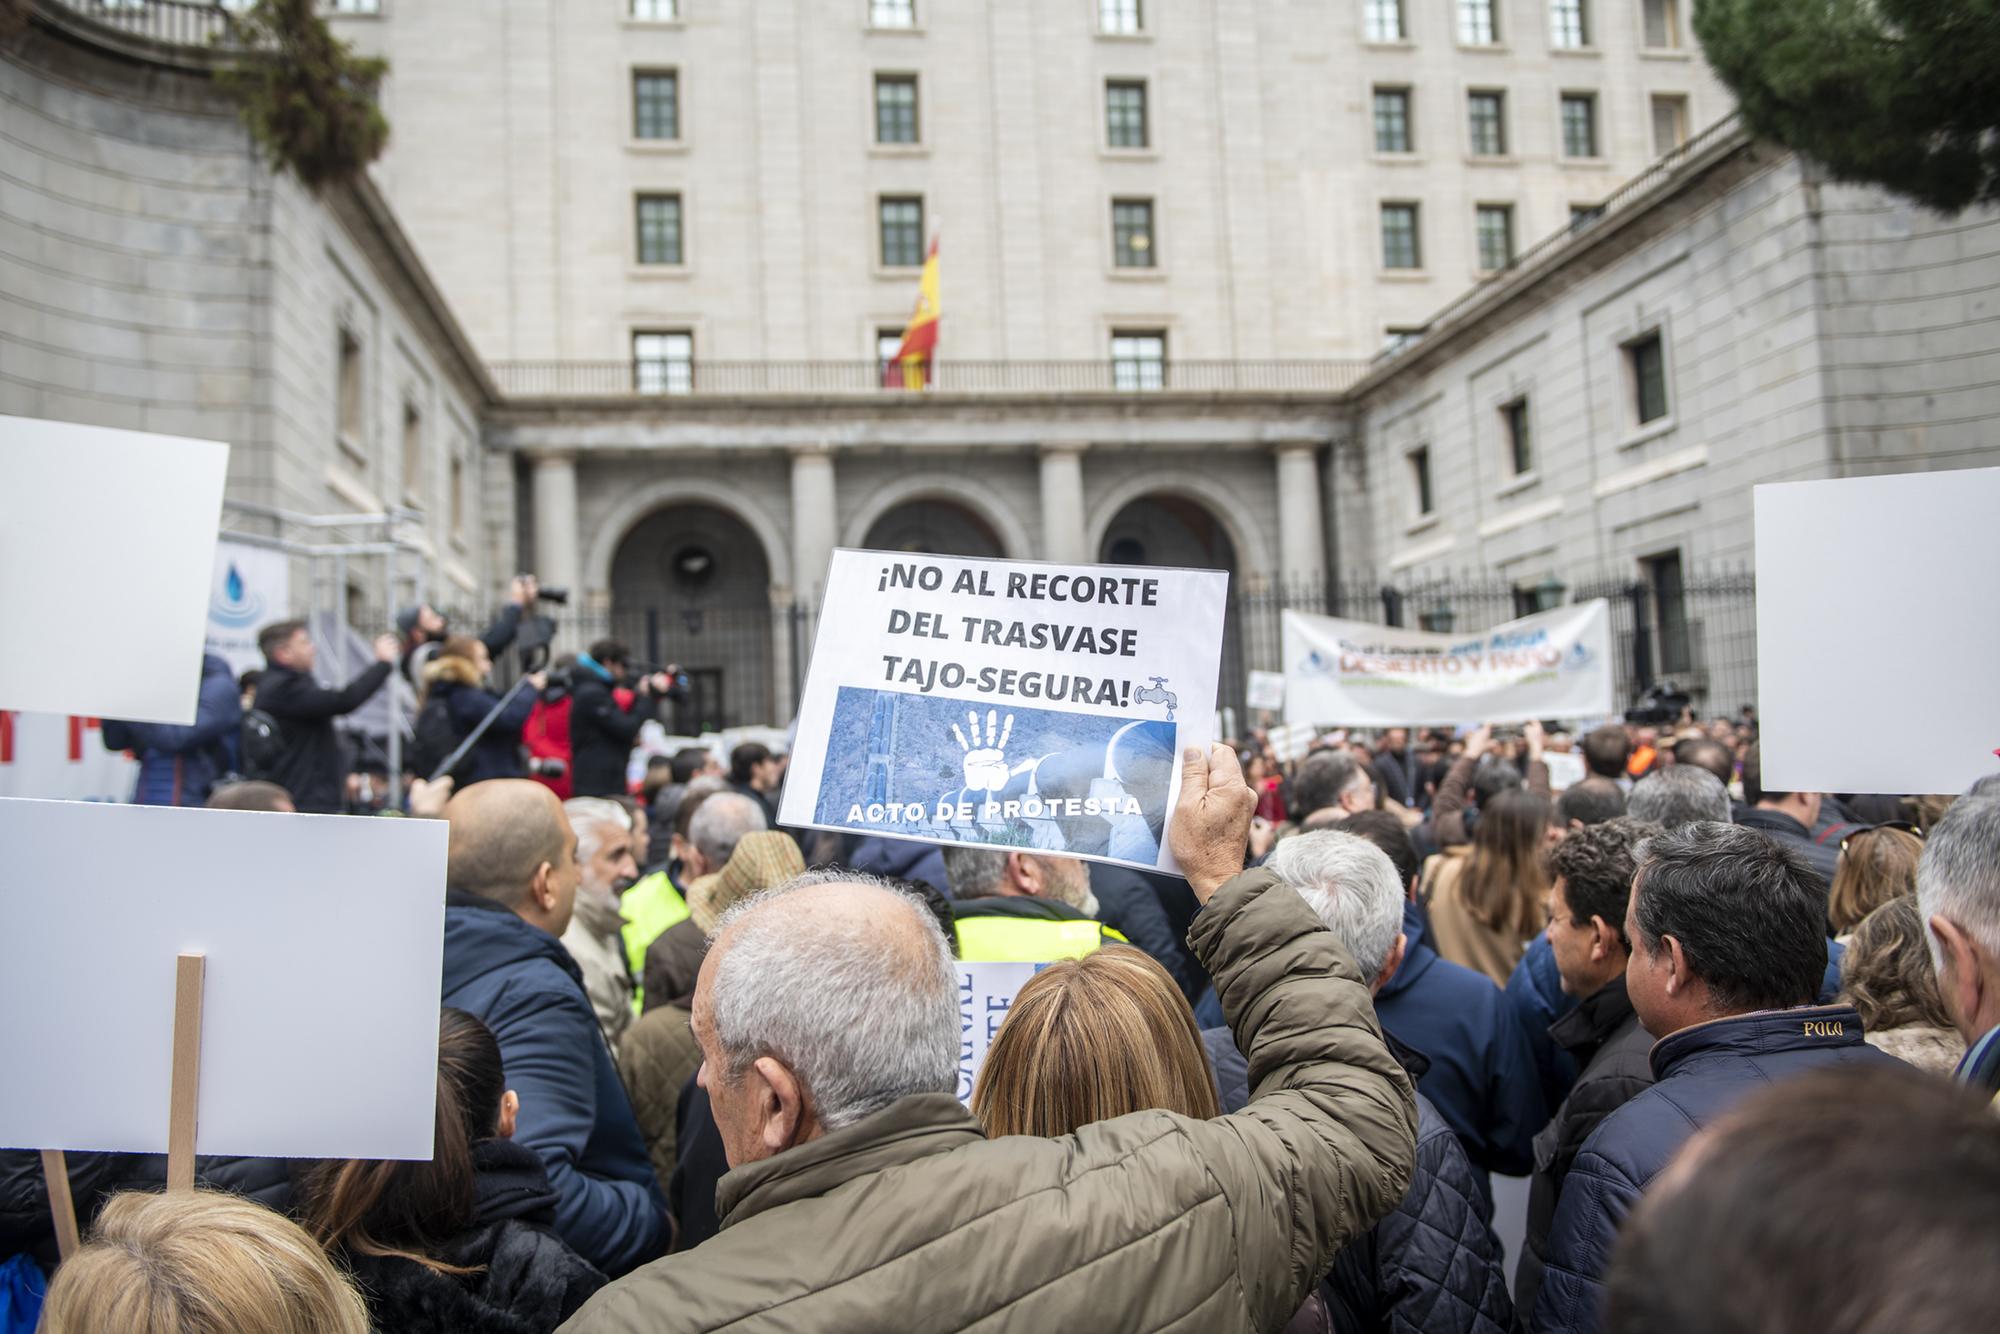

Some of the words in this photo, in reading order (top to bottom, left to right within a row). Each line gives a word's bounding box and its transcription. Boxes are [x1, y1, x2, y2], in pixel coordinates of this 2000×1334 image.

[878, 563, 942, 592] ¡NO
[951, 568, 995, 597] AL
[1006, 572, 1159, 607] RECORTE
[887, 609, 949, 640] DEL
[961, 616, 1138, 657] TRASVASE
[1465, 654, 1484, 672] Y
[882, 655, 1131, 708] TAJO-SEGURA!
[846, 802, 925, 823] ACTO
[936, 802, 976, 822] DE
[984, 797, 1143, 820] PROTESTA
[1803, 1021, 1844, 1037] POLO
